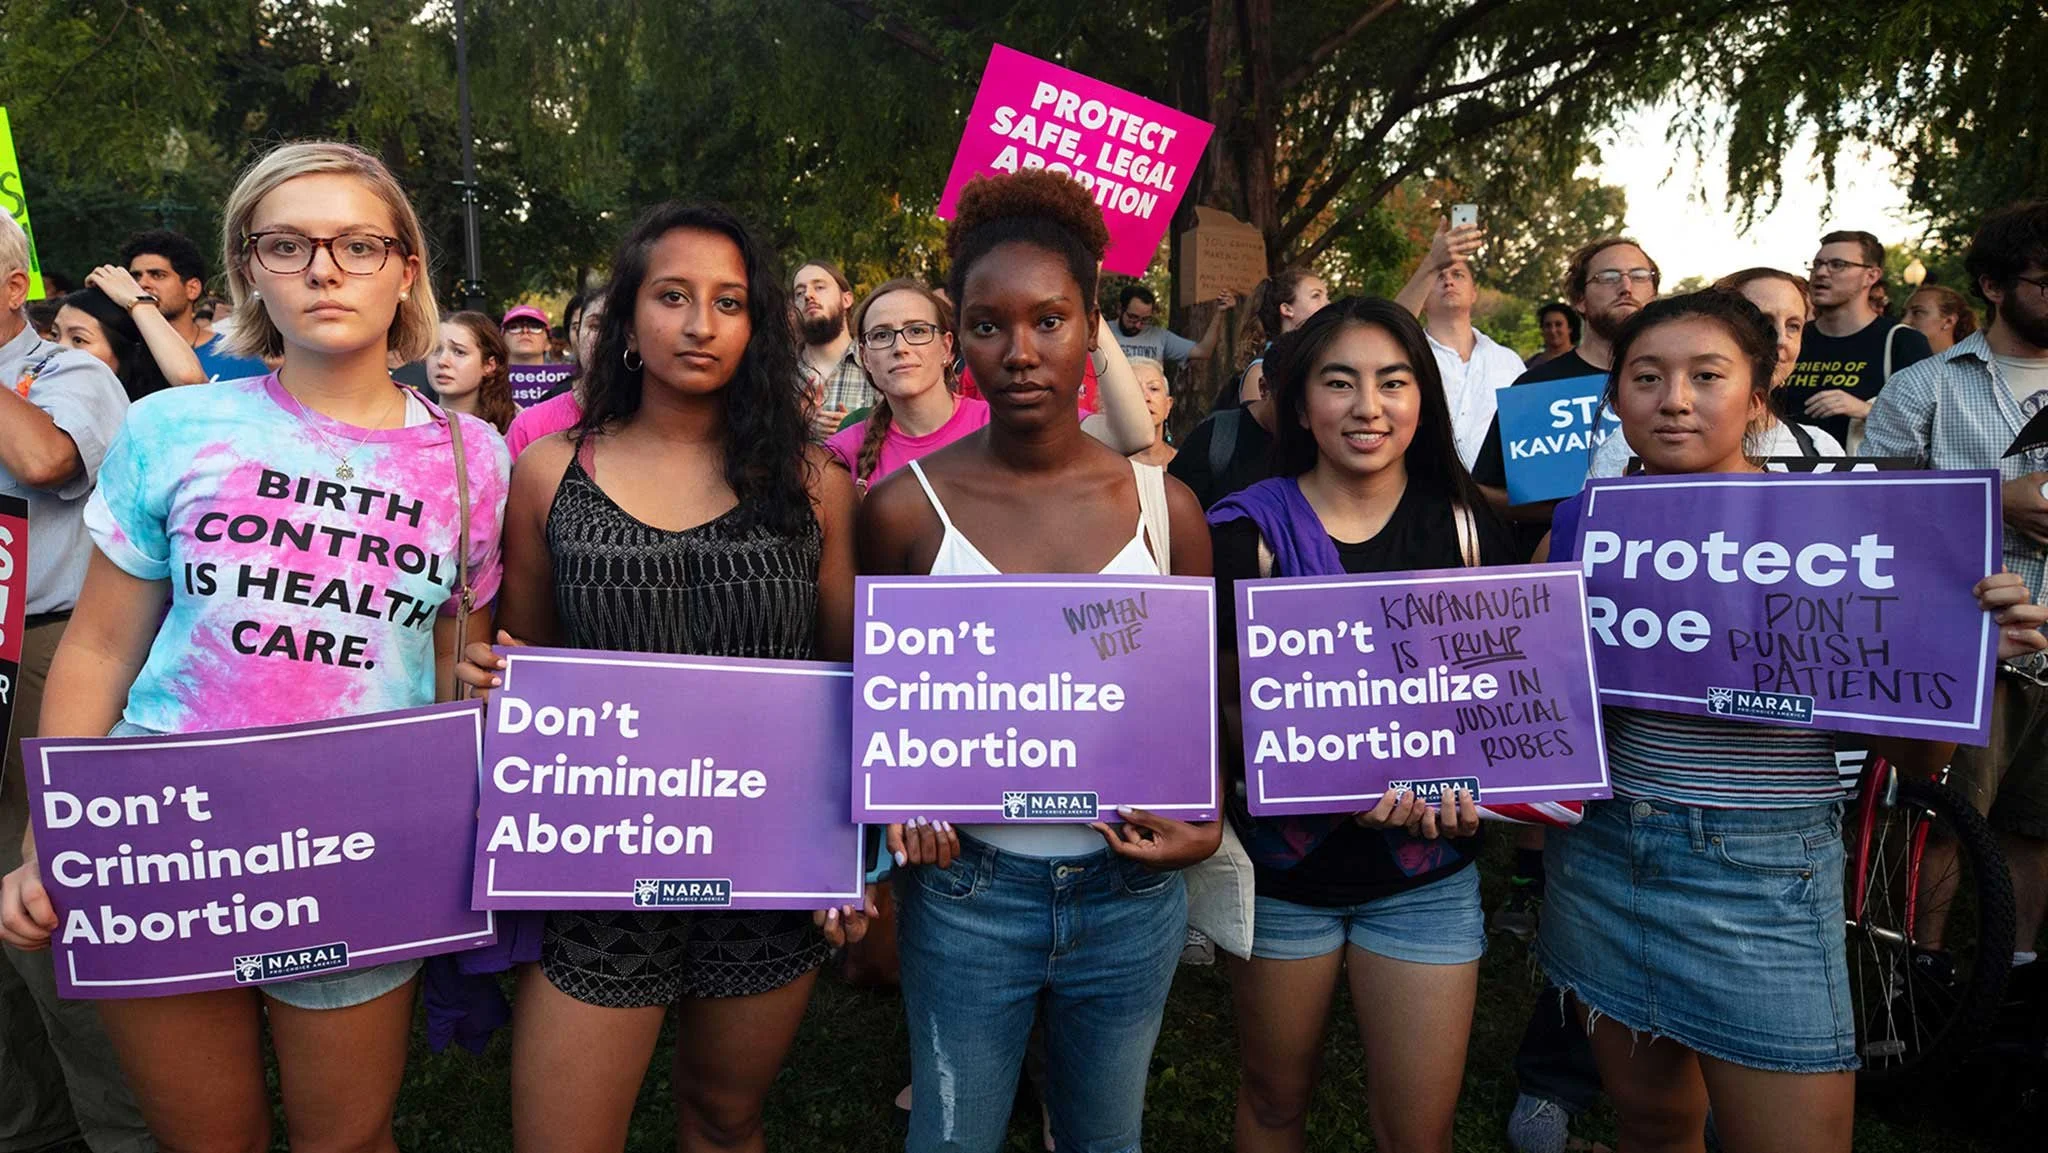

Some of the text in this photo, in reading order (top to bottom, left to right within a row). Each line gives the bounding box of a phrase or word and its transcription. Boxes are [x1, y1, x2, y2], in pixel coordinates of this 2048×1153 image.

[1031, 81, 1177, 155] PROTECT
[989, 106, 1177, 192] SAFE, LEGAL
[1822, 374, 1860, 387] POD
[1844, 362, 1867, 372] OF
[1510, 429, 1611, 459] KAVAN
[257, 469, 424, 528] BIRTH
[195, 512, 443, 585] CONTROL
[1584, 530, 1896, 590] Protect
[185, 563, 435, 630] IS HEALTH
[1062, 591, 1149, 635] WOMEN
[1380, 583, 1550, 630] KAVANAUGH
[1765, 592, 1900, 633] DON'T
[232, 620, 375, 670] CARE.
[865, 621, 996, 655] Don't
[1090, 622, 1144, 660] VOTE
[1247, 621, 1375, 658] Don't
[1589, 596, 1712, 652] Roe
[1391, 626, 1523, 674] IS TRUMP
[1728, 628, 1890, 667] PUNISH
[863, 671, 1126, 712] Criminalize
[1250, 665, 1499, 711] Criminalize
[1509, 667, 1543, 697] IN
[1738, 694, 1806, 712] NARAL
[1753, 659, 1959, 710] PATIENTS
[498, 697, 640, 739] Don't
[1455, 698, 1568, 735] JUDICIAL
[861, 727, 1077, 768] Abortion
[1253, 721, 1456, 764] Abortion
[1480, 728, 1574, 768] ROBES
[492, 753, 767, 798] Criminalize
[43, 785, 212, 829] Don't
[1031, 796, 1092, 809] NARAL
[486, 813, 713, 855] Abortion
[51, 828, 375, 887] Criminalize
[663, 883, 725, 896] NARAL
[61, 893, 319, 944] Abortion
[268, 948, 341, 969] NARAL
